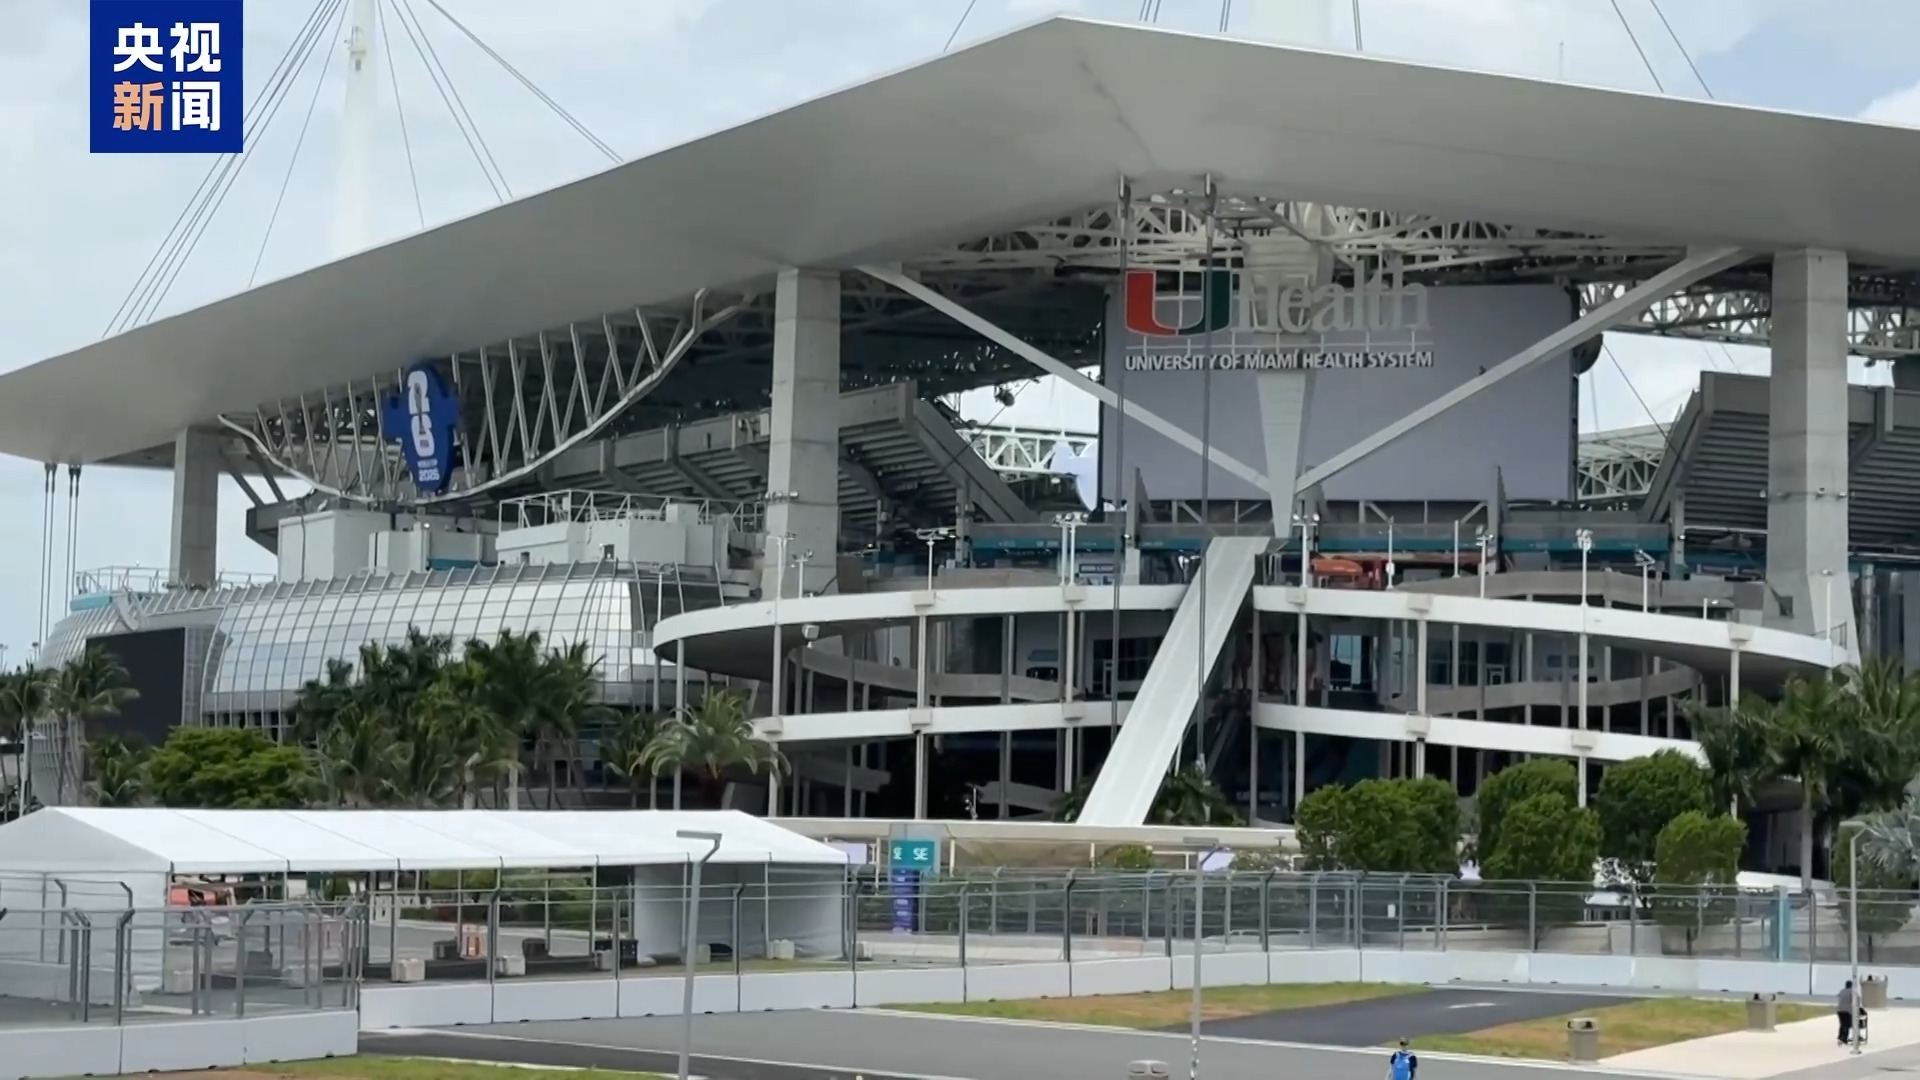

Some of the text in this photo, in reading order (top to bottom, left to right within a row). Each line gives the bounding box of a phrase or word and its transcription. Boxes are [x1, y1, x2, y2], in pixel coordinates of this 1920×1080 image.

[1124, 350, 1434, 371] UNIVERSITY OF MIAMI HEALTH SYSTEM
[913, 847, 929, 860] SE
